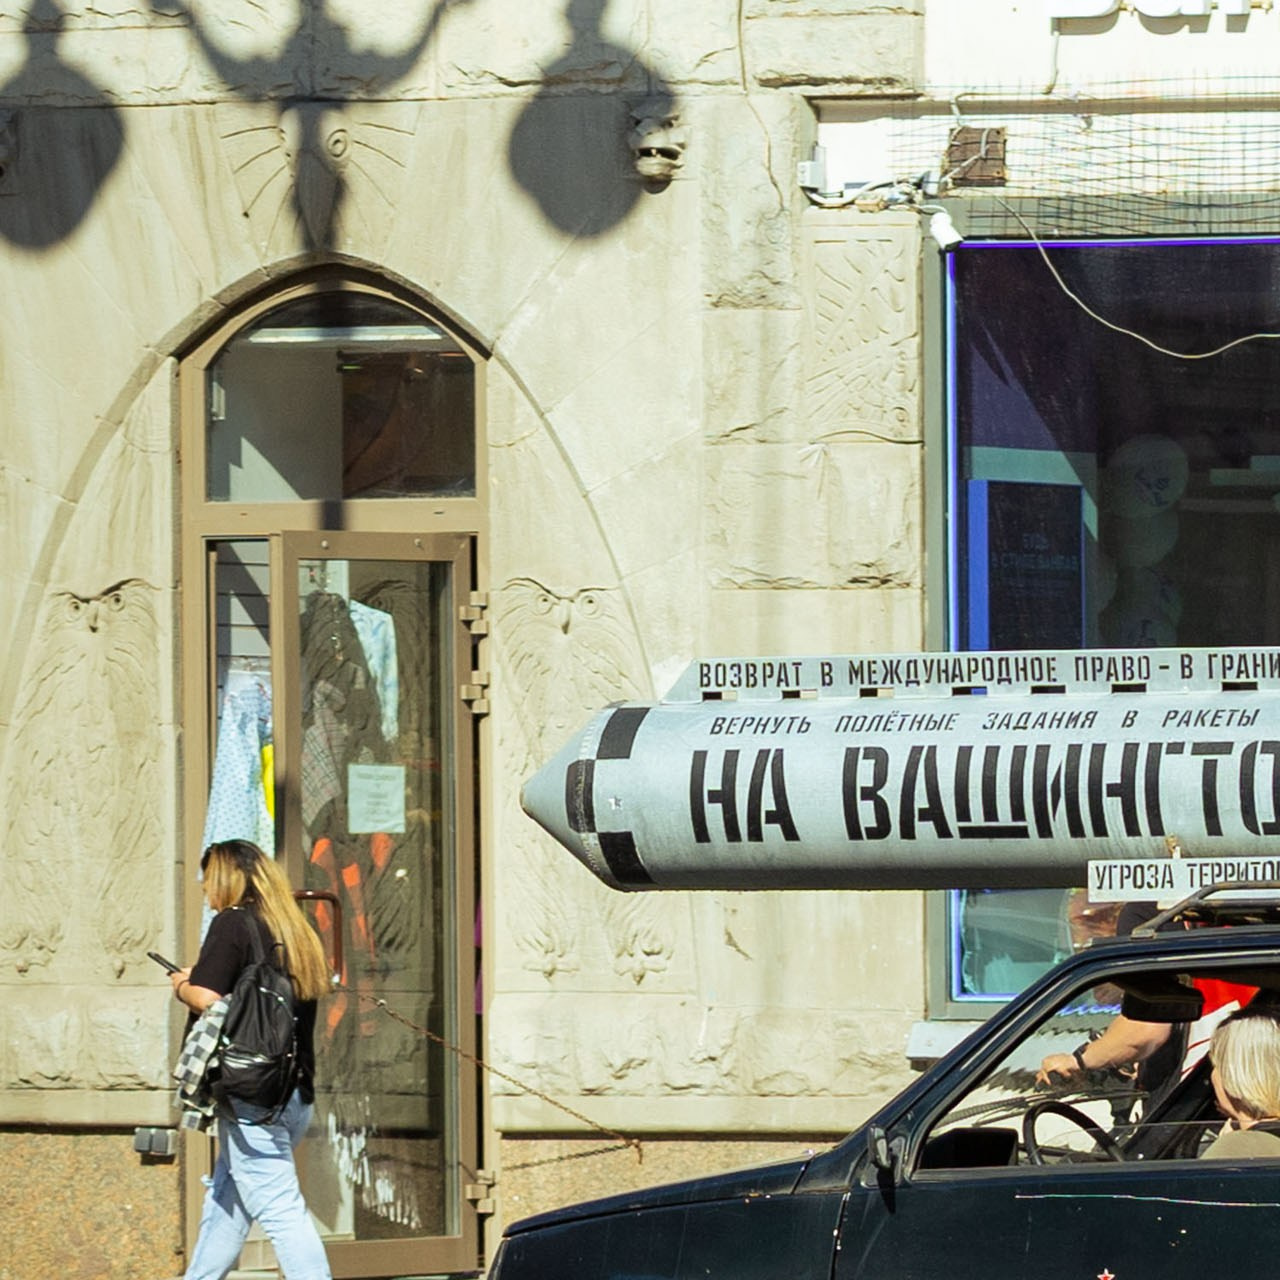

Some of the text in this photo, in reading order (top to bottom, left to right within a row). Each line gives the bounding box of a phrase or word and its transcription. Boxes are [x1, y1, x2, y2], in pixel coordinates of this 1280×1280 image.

[699, 661, 803, 688] ВОЗВРАТ
[821, 661, 834, 687] В
[849, 656, 1058, 687] МЕЖДУНАРОДНОЕ
[1181, 652, 1194, 680] В
[709, 715, 812, 735] ВЕРНУТЬ
[834, 711, 960, 734] ПОЛЁТНЫЕ
[982, 710, 1099, 731] ЗАДАНИЯ
[1121, 709, 1139, 729] В
[1162, 708, 1261, 729] РАКЕТЫ
[689, 748, 800, 843] НА
[1095, 863, 1175, 889] УГРОЗА
